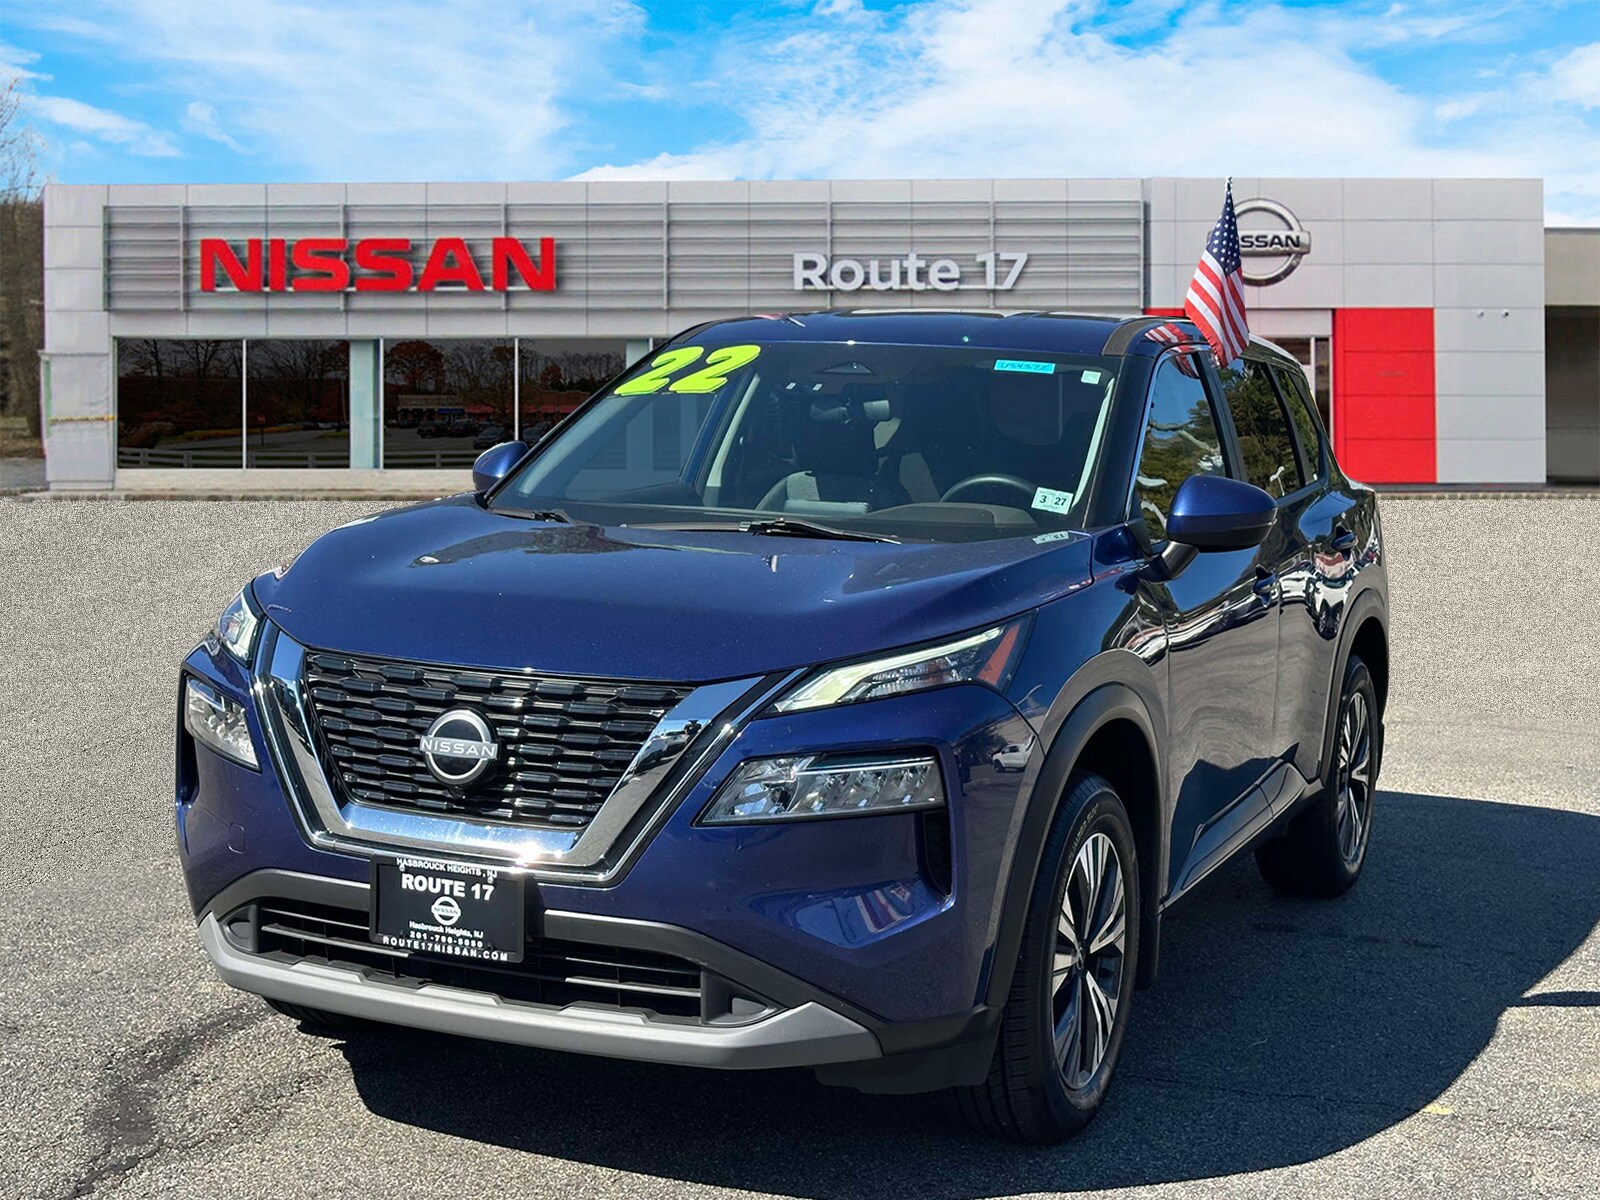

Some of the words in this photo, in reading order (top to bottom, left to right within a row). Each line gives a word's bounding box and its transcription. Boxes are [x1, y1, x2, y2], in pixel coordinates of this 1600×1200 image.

[1240, 235, 1300, 248] SSAN
[200, 237, 556, 292] NISSAN
[793, 252, 960, 291] Route
[976, 251, 1029, 290] 17
[613, 345, 761, 396] 22
[1039, 494, 1047, 504] 3
[1053, 496, 1067, 506] 27
[421, 739, 495, 757] NISSAN
[396, 857, 446, 872] HASBROUCK
[487, 869, 498, 879] NJ
[401, 873, 466, 898] ROUTE
[471, 883, 495, 901] 17
[433, 906, 459, 915] NISSAN
[409, 920, 444, 933] Hasbrouck
[473, 930, 484, 939] NJ
[382, 936, 508, 962] ROUTE17NISSAN.COM
